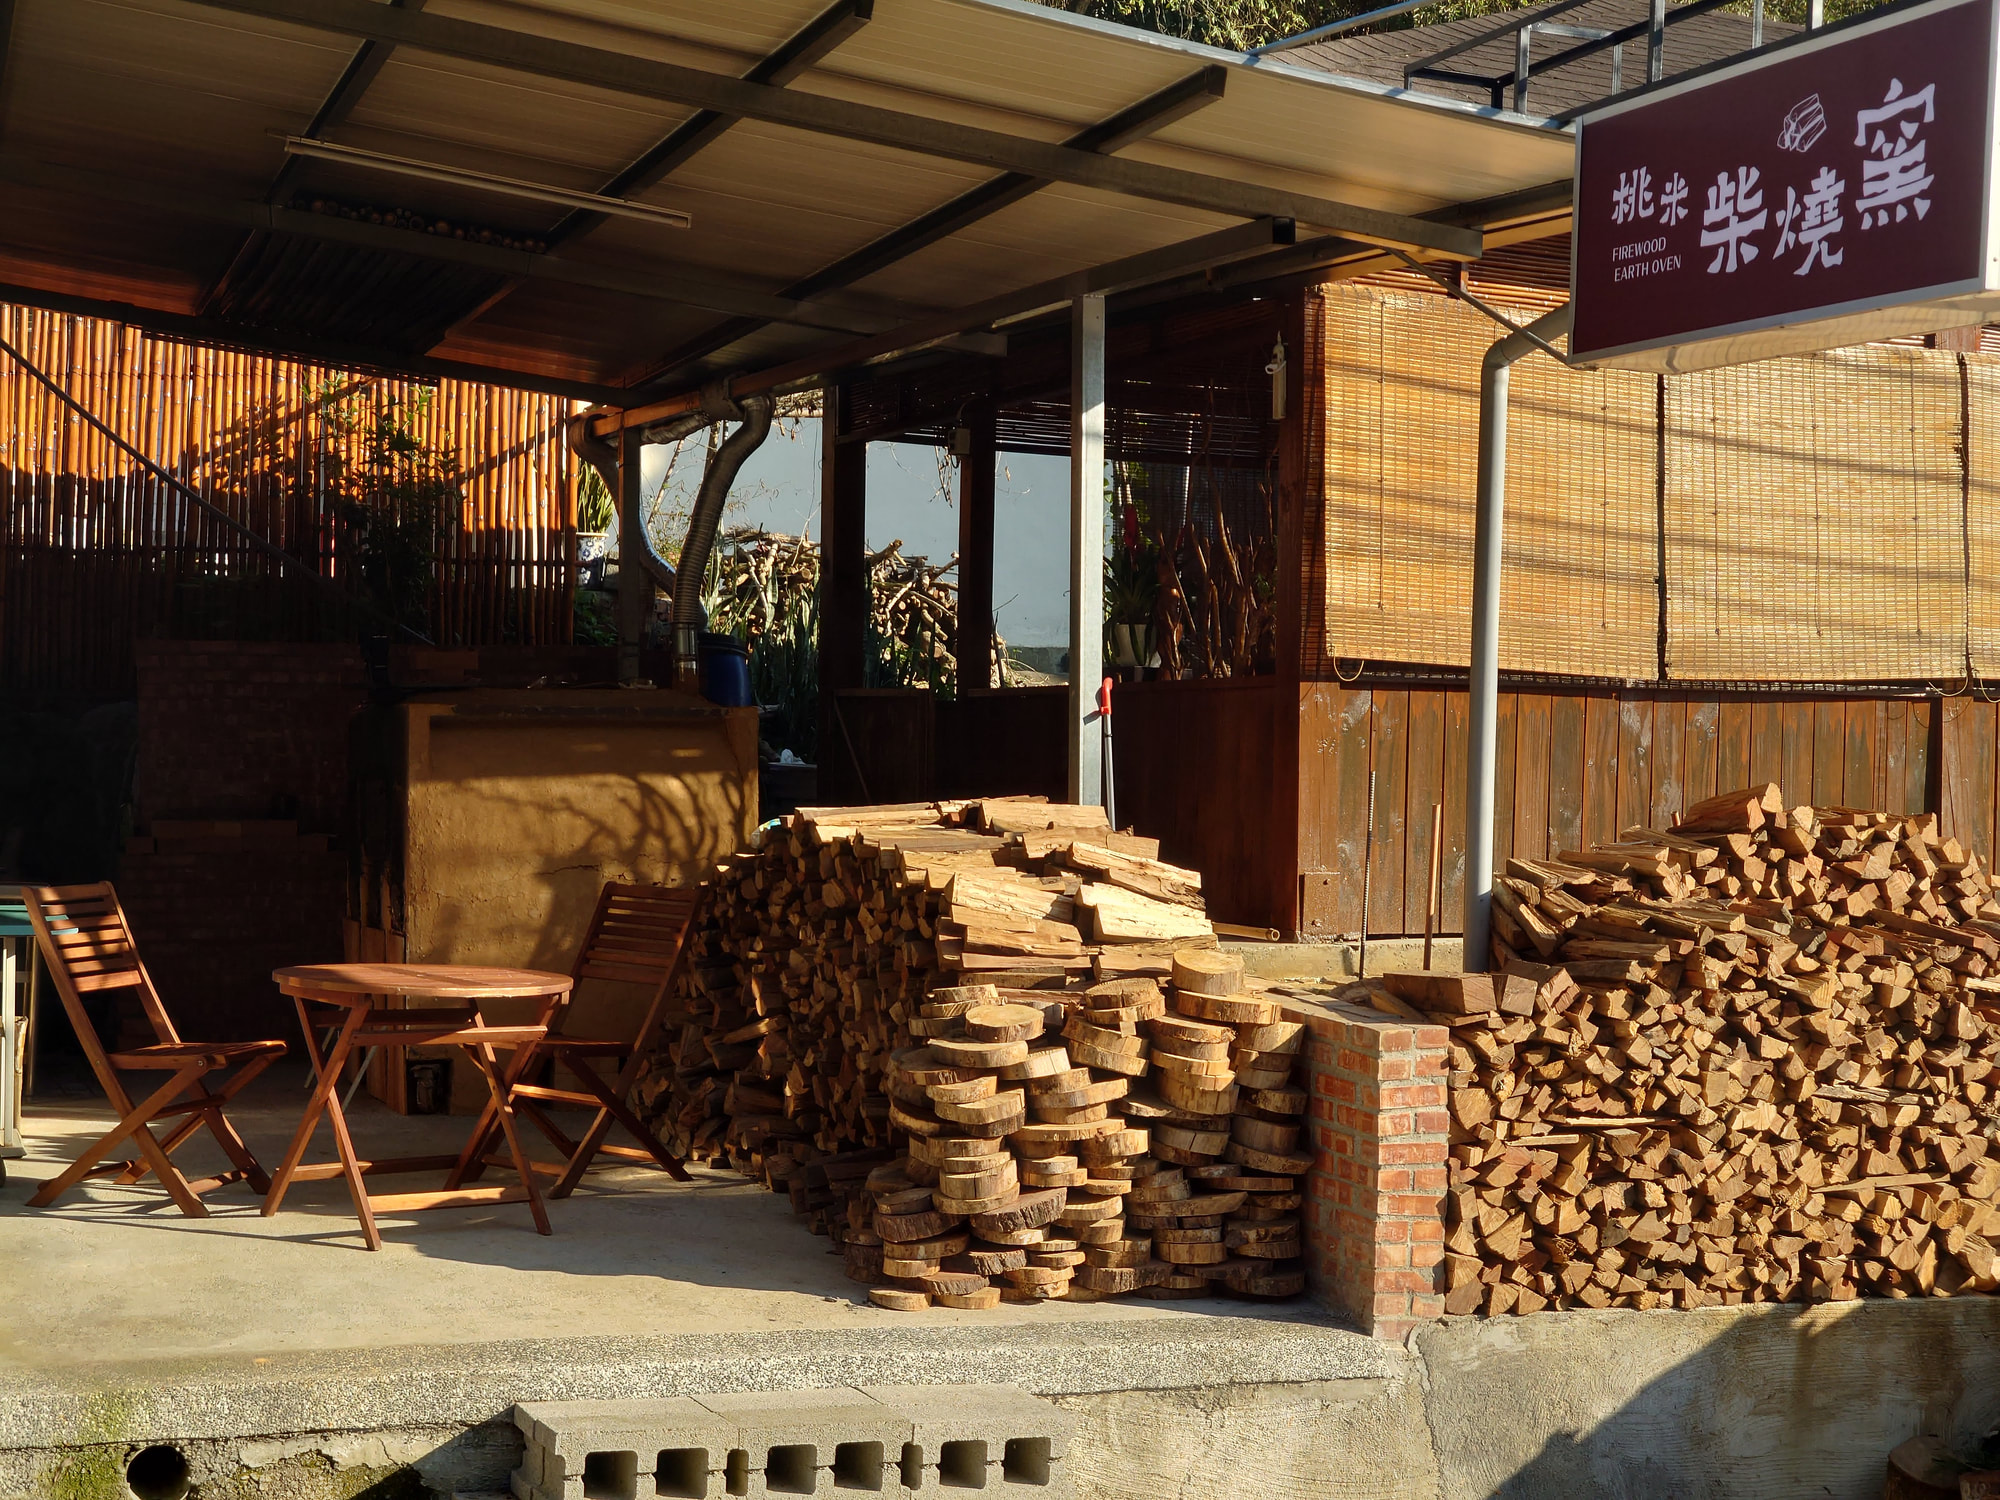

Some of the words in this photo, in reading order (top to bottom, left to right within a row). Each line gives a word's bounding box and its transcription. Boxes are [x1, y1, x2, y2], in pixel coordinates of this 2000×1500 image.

[1611, 166, 1689, 226] 桃米
[1612, 237, 1667, 261] FIREWOOD
[1614, 262, 1649, 282] EARTH
[1651, 255, 1682, 274] OVEN
